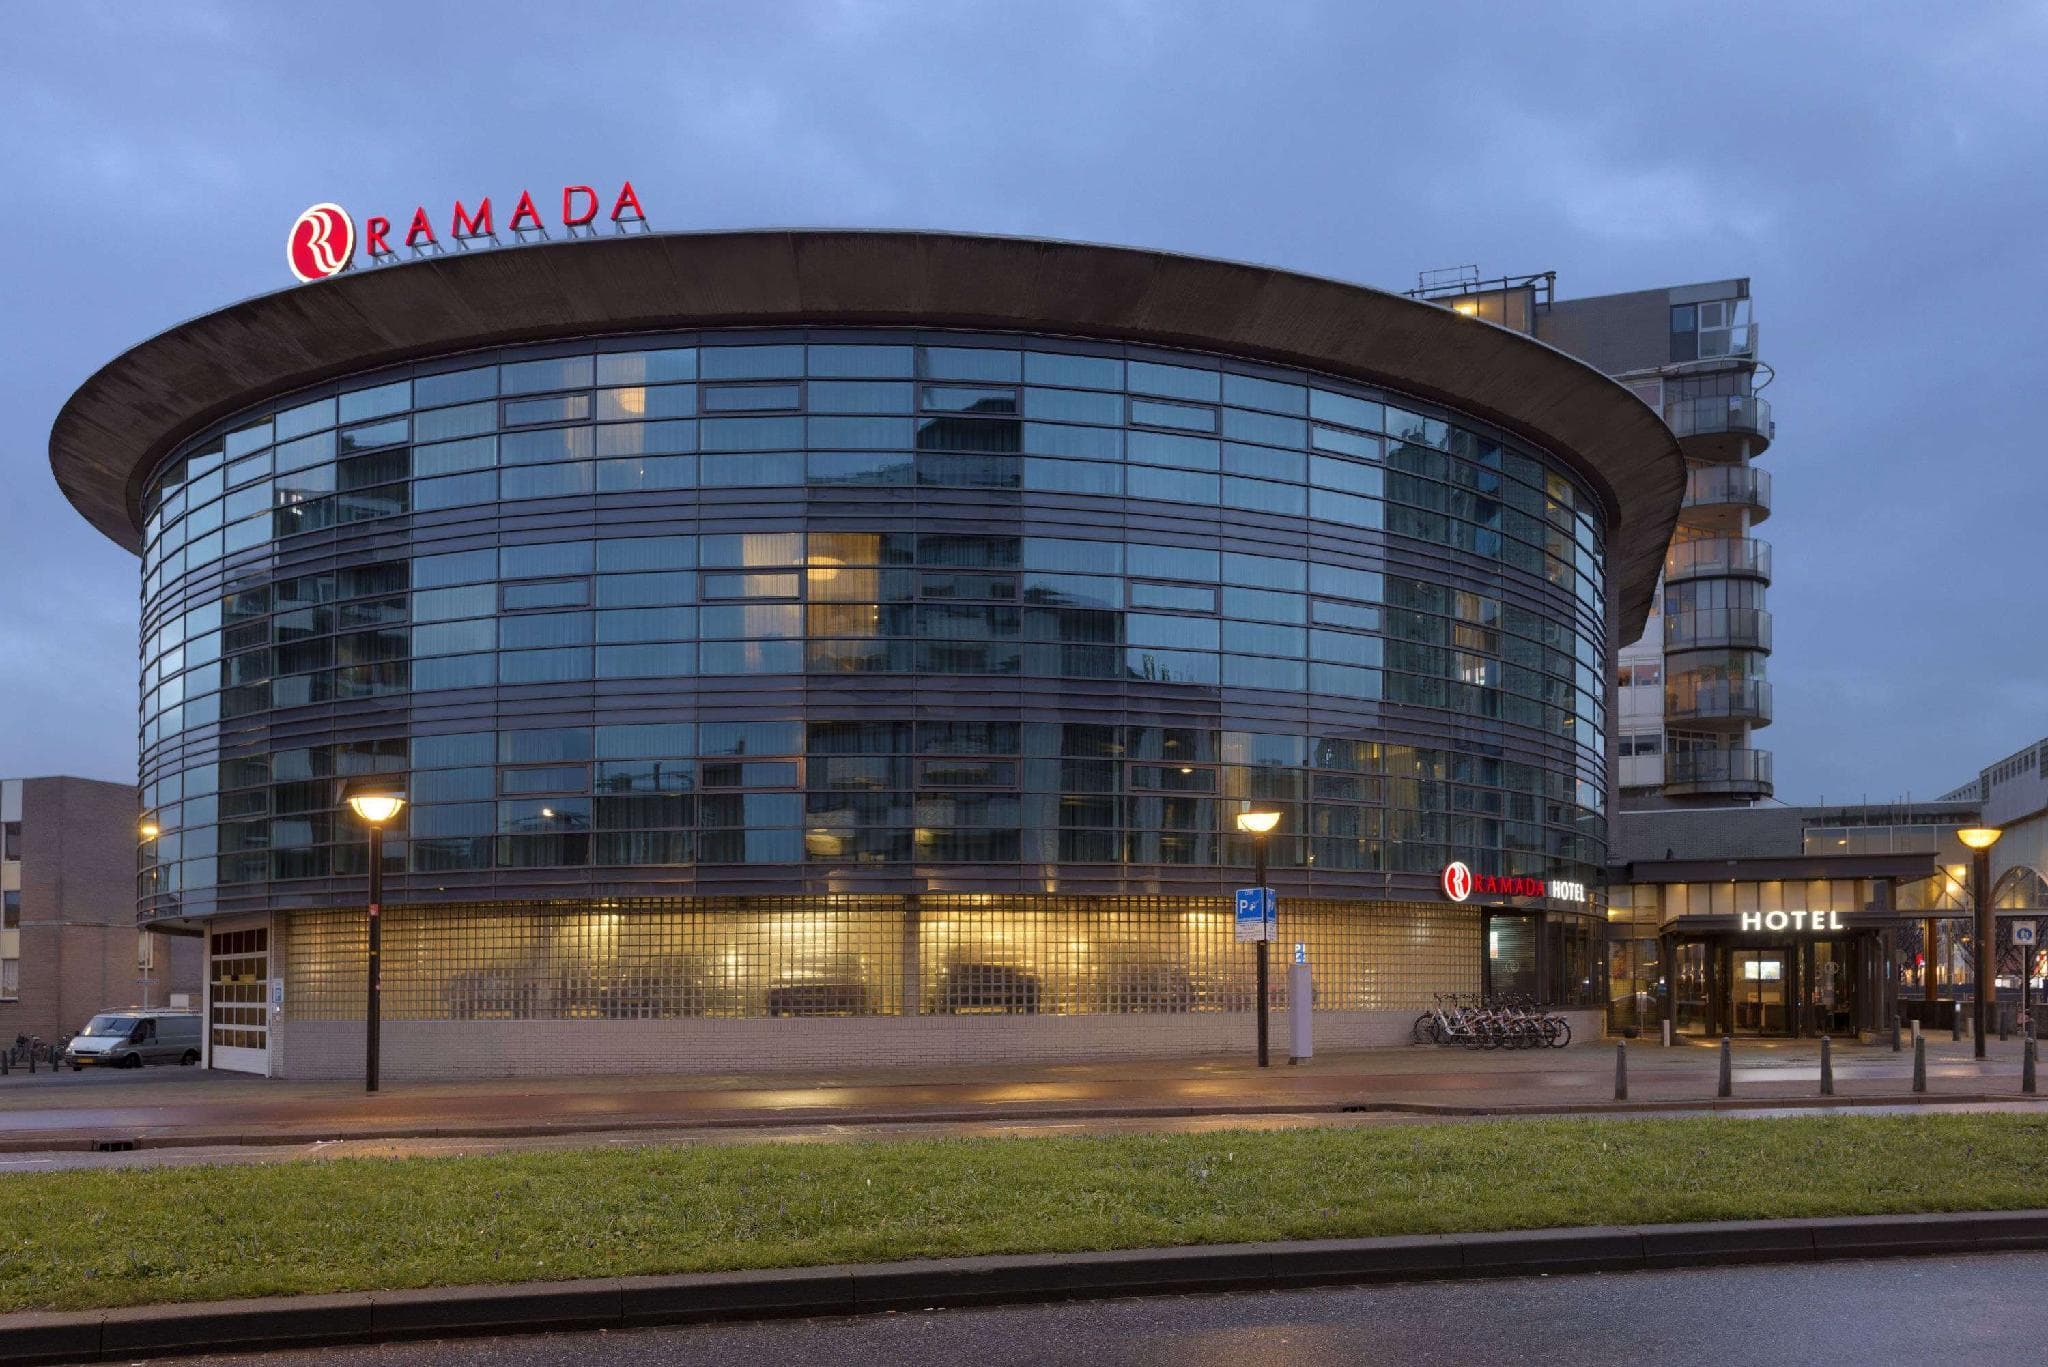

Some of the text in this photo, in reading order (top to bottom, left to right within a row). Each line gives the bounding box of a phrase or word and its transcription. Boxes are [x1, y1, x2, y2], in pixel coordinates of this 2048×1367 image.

[366, 181, 645, 256] RAMADA
[1473, 873, 1545, 897] RAMADA
[1552, 880, 1585, 902] HOTEL
[1240, 900, 1248, 914] P
[1742, 911, 1843, 930] HOTEL
